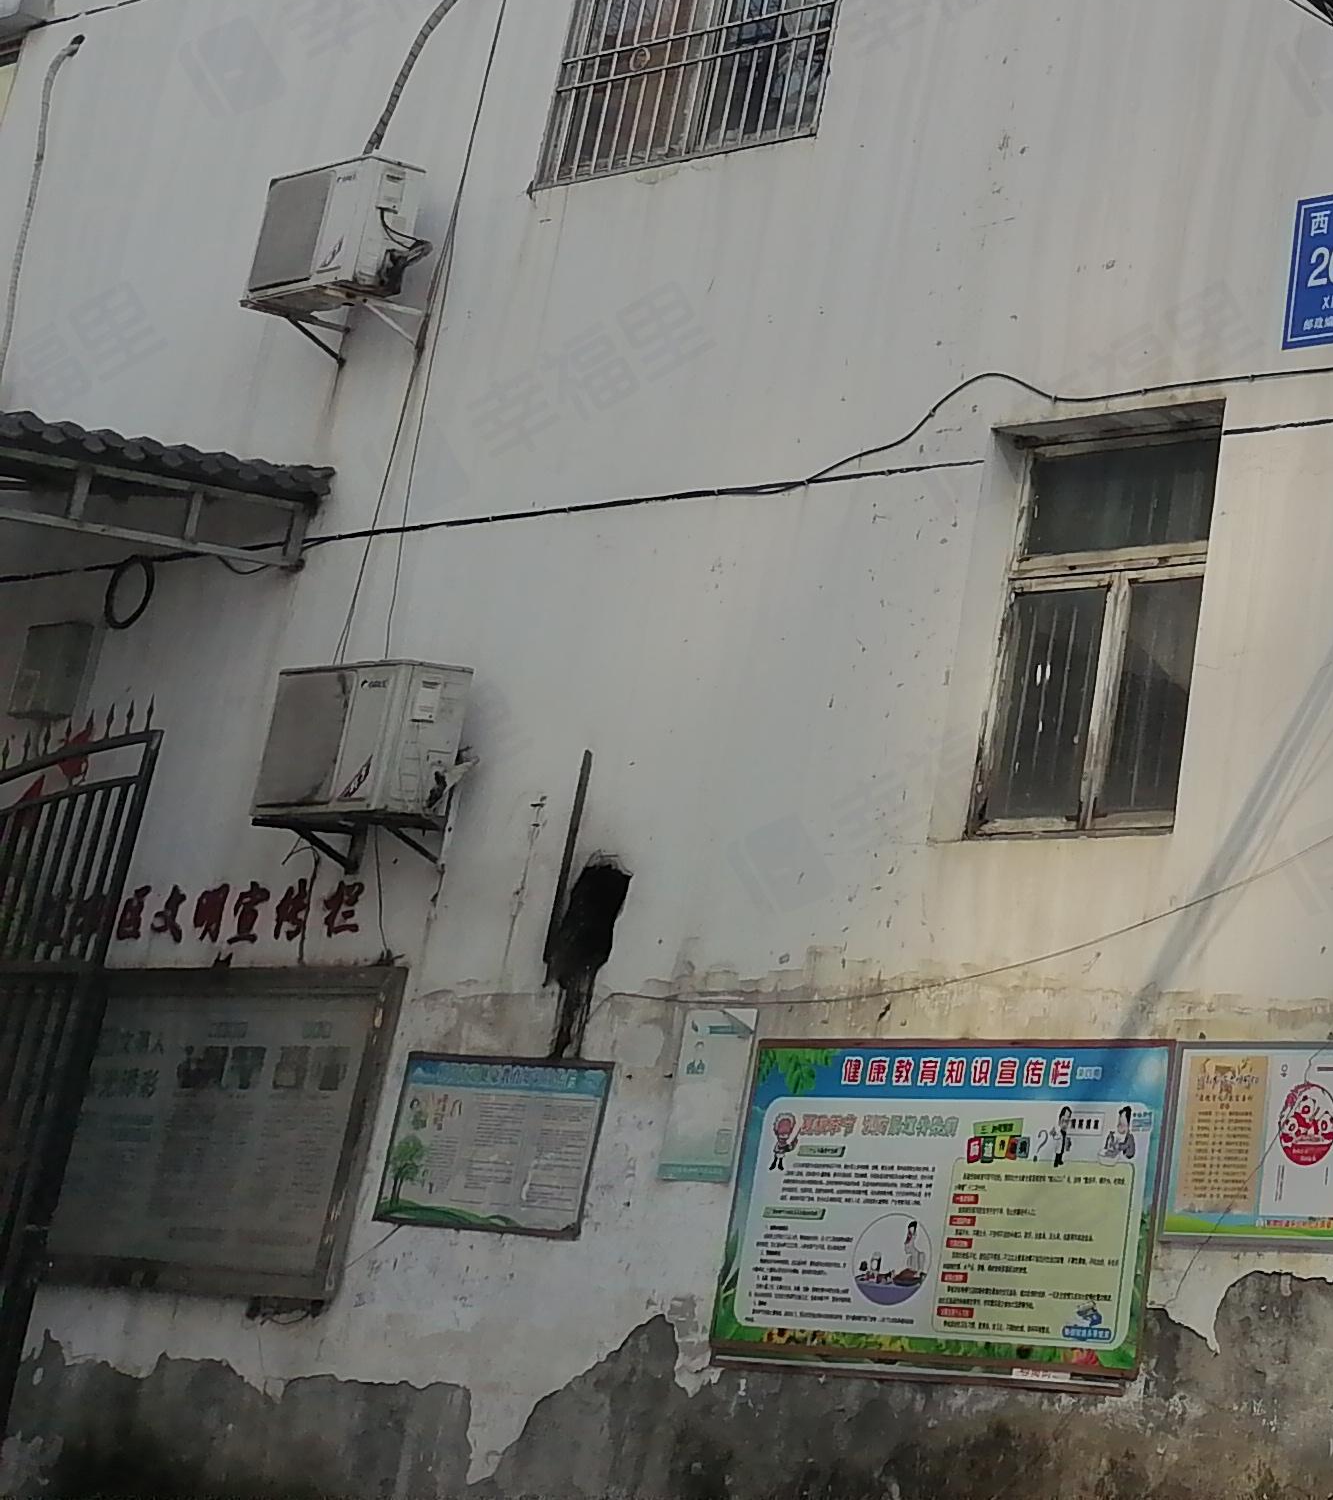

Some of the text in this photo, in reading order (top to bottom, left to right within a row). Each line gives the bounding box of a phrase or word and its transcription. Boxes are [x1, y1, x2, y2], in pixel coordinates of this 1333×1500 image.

[68, 877, 365, 944] 区文明宣传栏
[842, 1056, 1074, 1088] 健康教育知识宣传栏
